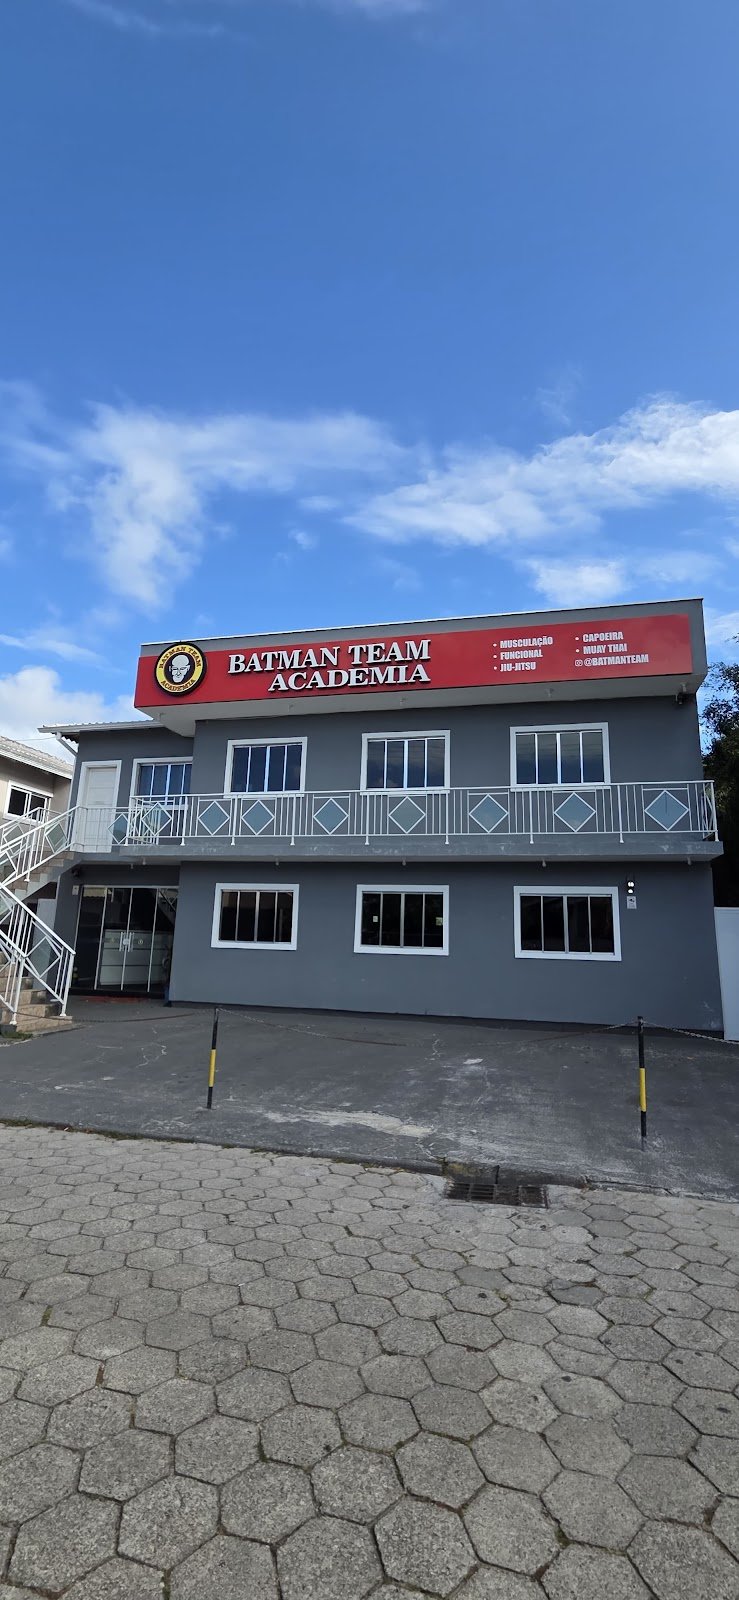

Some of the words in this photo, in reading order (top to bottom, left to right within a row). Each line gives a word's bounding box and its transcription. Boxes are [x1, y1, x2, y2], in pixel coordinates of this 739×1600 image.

[499, 636, 554, 649] MUSCULAÇÃO
[583, 631, 624, 643] CAPOEIRA
[500, 649, 543, 661] FUNCIONAL
[583, 644, 606, 655] MUAY
[608, 643, 628, 653] THAI
[228, 646, 340, 674] BATMAN
[348, 639, 431, 665] TEAM
[584, 654, 649, 667] @BATMANTEAM
[500, 661, 536, 672] JIU-JITSU
[268, 663, 431, 692] ACADEMIA
